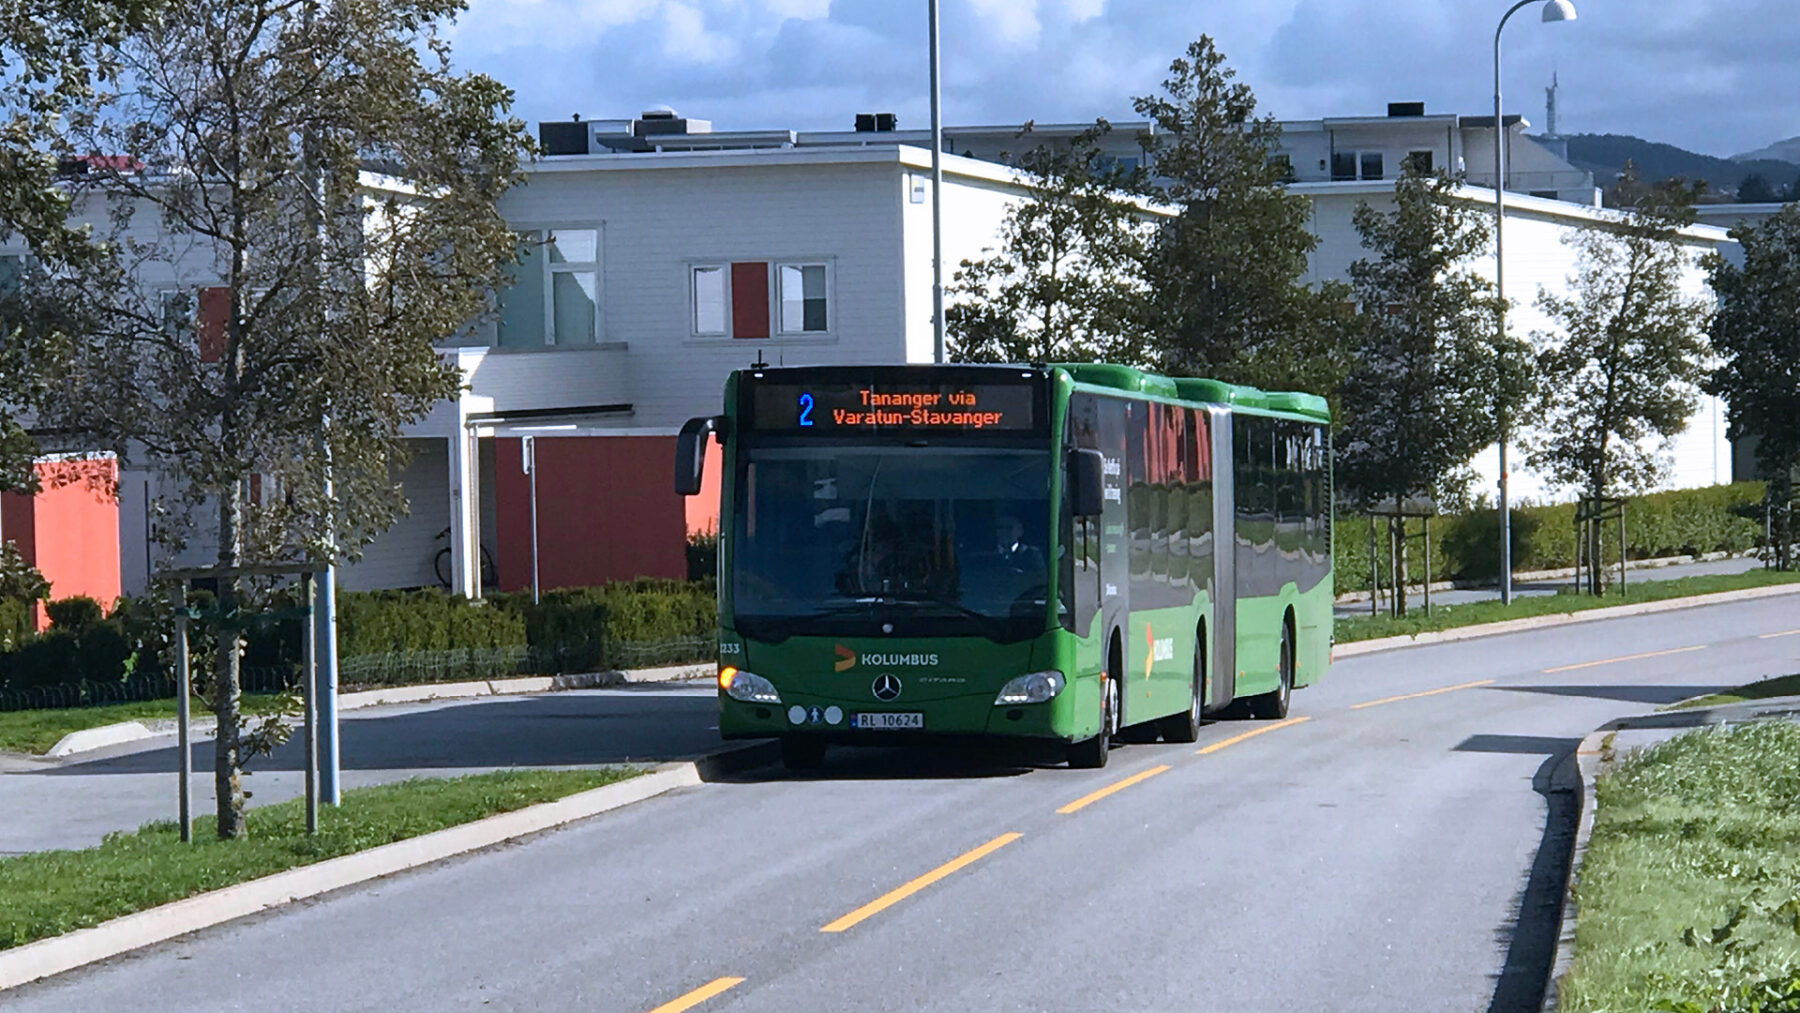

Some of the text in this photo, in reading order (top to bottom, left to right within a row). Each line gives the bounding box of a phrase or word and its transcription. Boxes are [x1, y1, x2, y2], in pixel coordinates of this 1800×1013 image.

[859, 390, 977, 408] Tananger via
[799, 393, 815, 427] 2
[833, 409, 1003, 429] Varatun-Stavanger
[861, 653, 939, 666] KOLUMBUS
[861, 714, 919, 727] RL 10624
